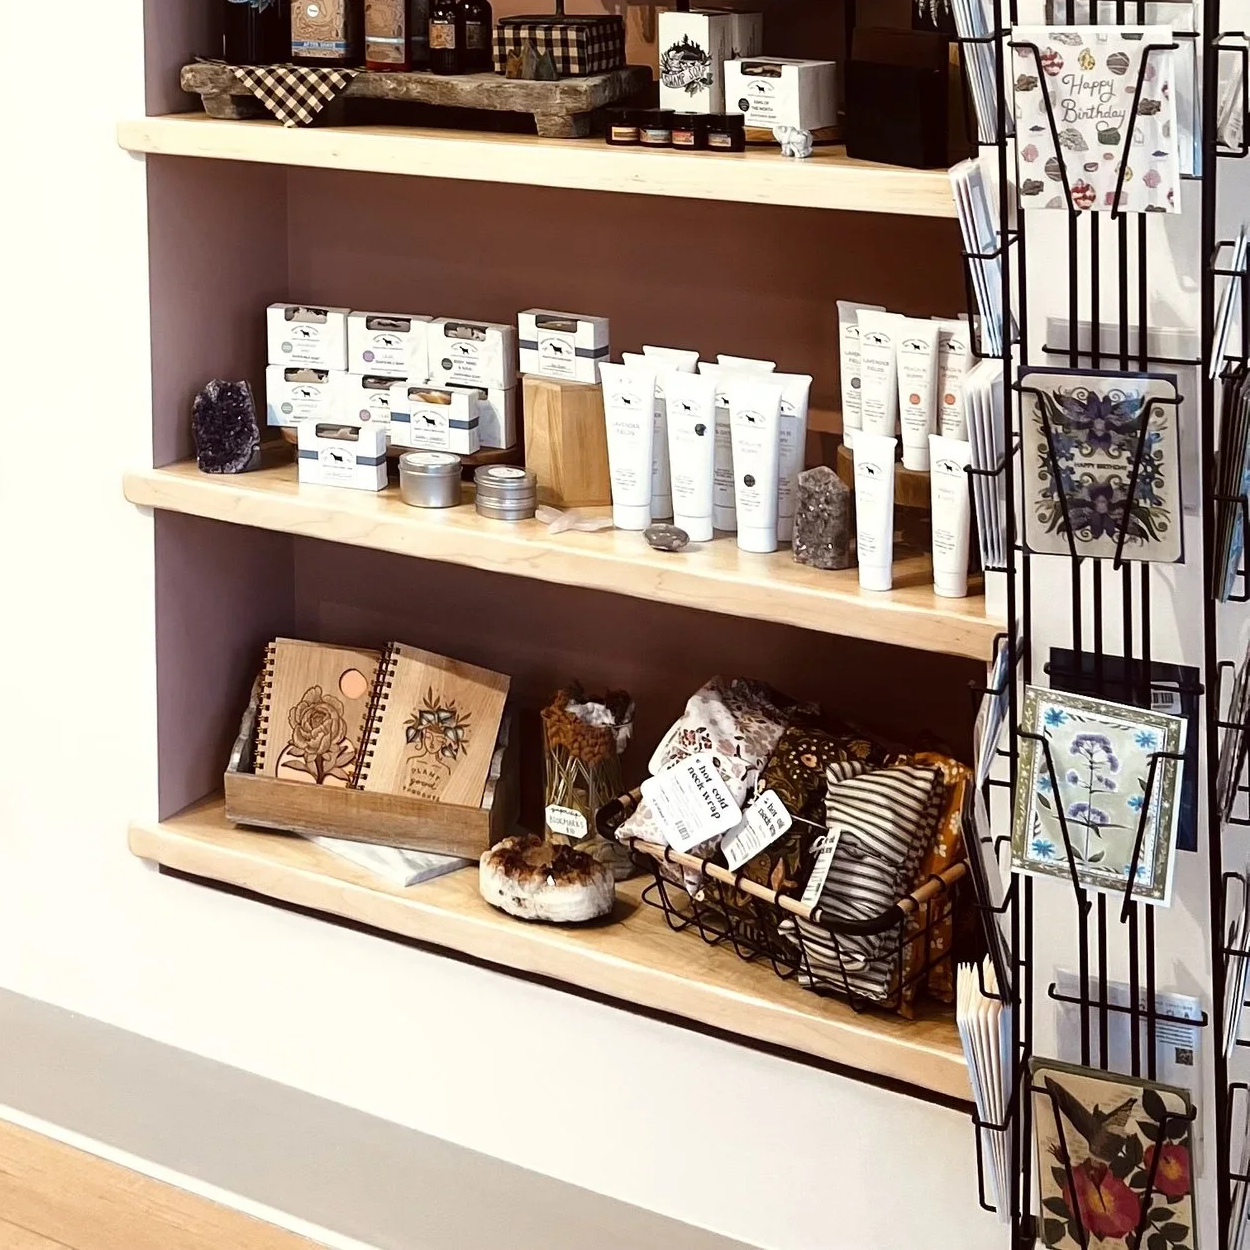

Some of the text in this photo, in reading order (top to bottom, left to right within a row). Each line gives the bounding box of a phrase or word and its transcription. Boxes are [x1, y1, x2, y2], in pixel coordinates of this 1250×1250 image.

[663, 72, 686, 87] SWAMP
[1061, 73, 1116, 103] Happy
[1060, 98, 1126, 132] Birthday
[687, 766, 721, 819] neck wrap
[698, 765, 730, 810] hot cold
[549, 814, 584, 829] BOOKMARKS
